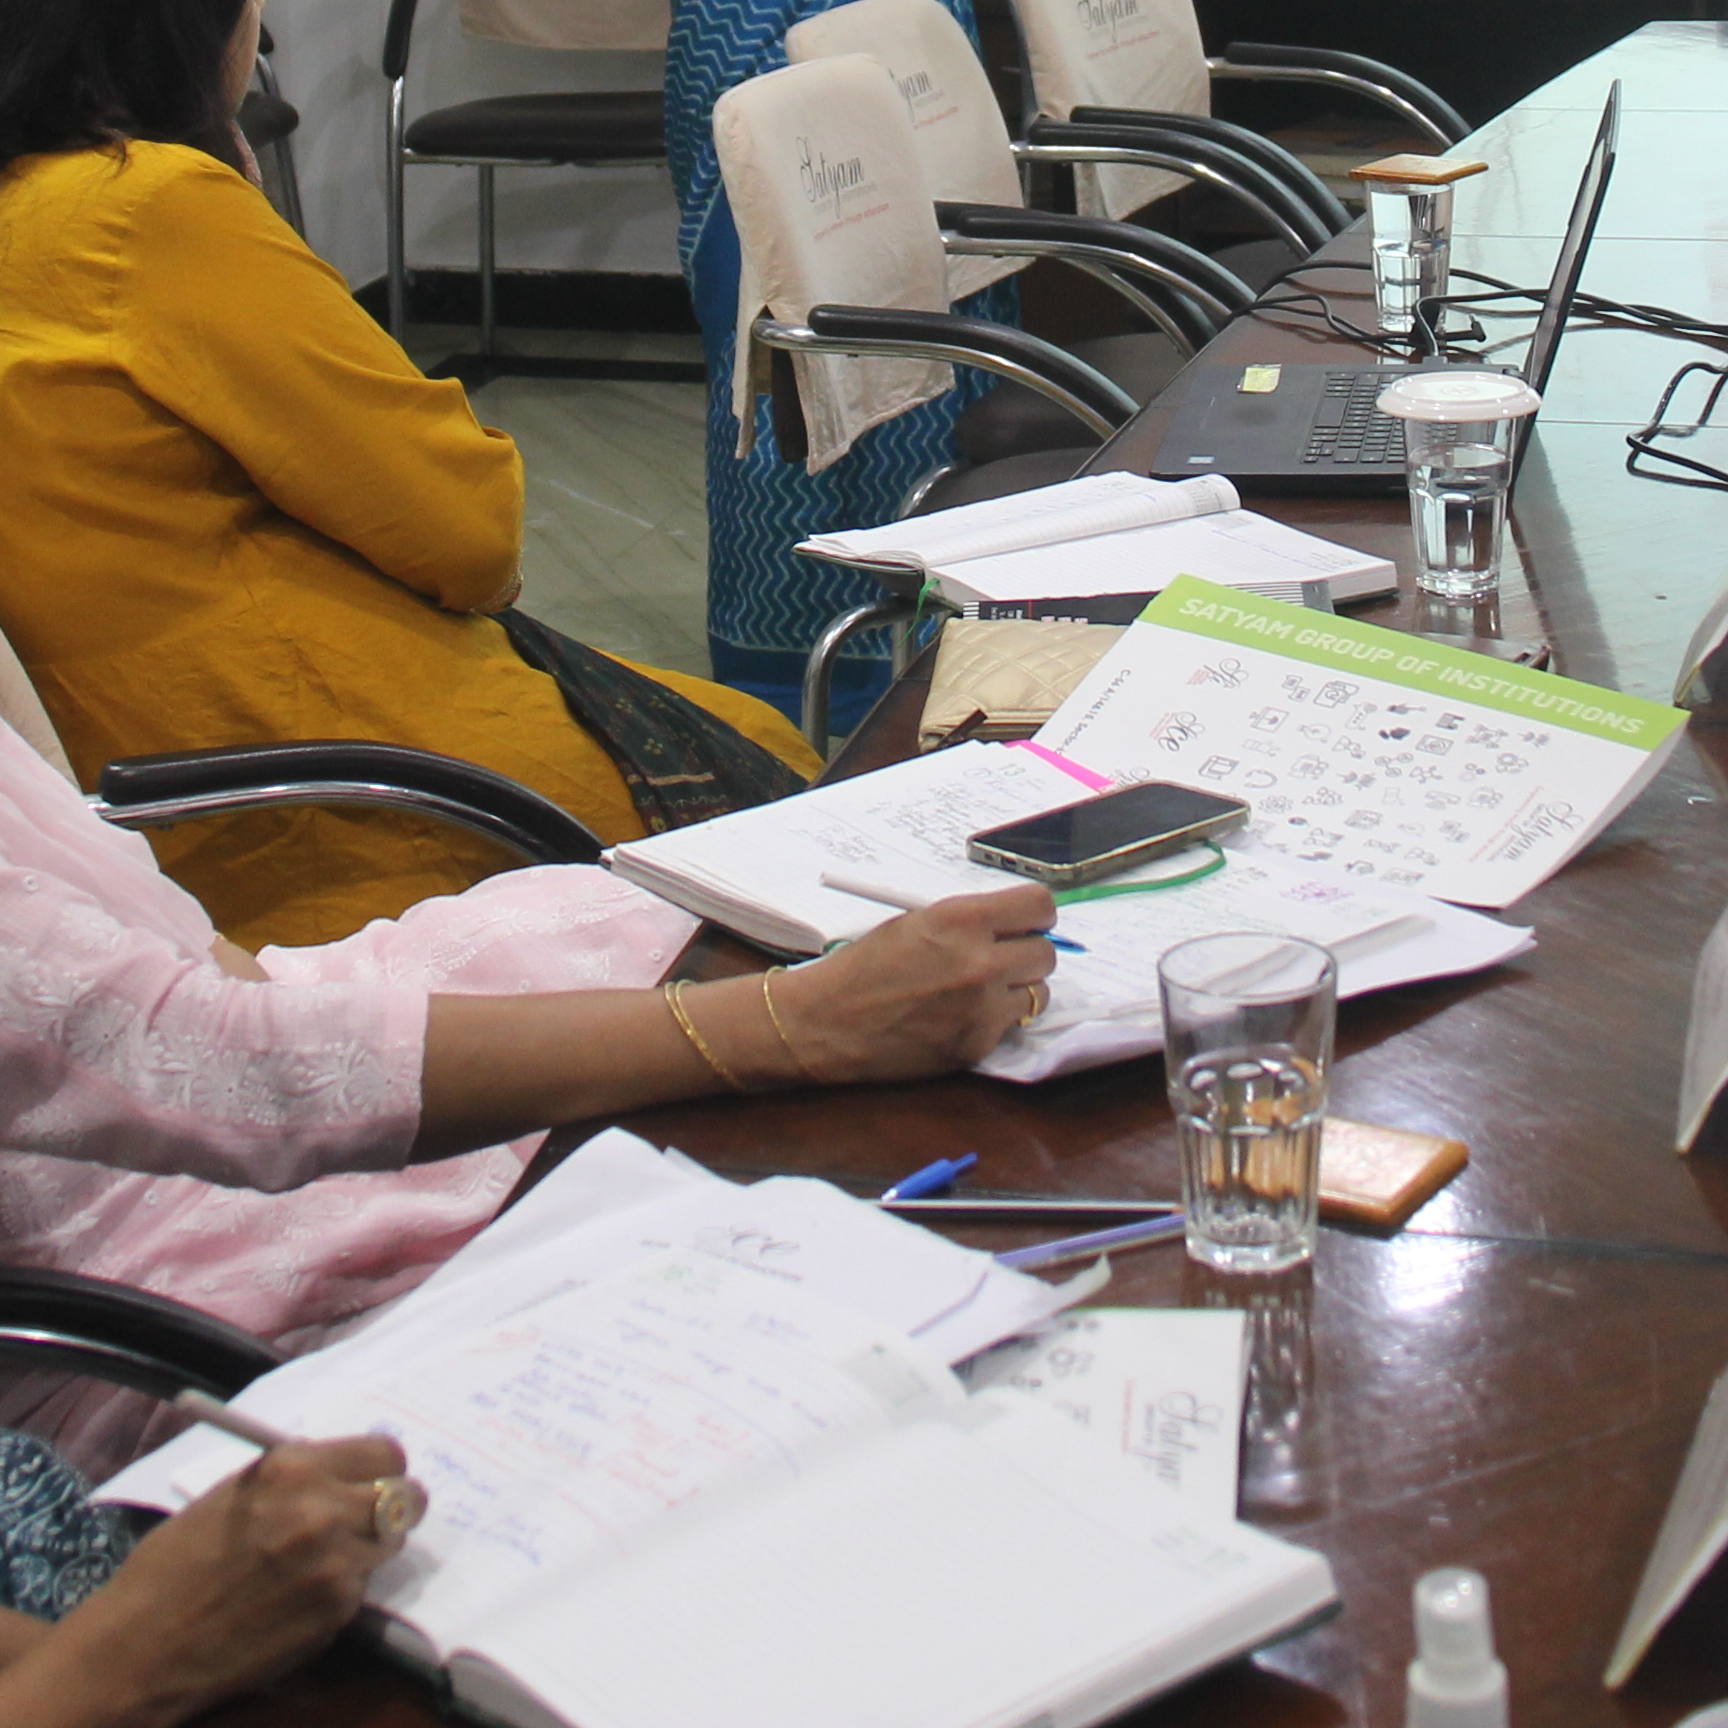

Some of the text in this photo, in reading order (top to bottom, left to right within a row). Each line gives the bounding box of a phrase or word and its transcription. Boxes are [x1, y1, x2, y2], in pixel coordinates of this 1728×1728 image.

[796, 136, 865, 219] Satyam
[1178, 597, 1647, 738] SATYAM GROUP OF INSTITUTIONS
[1500, 801, 1584, 861] Satyam
